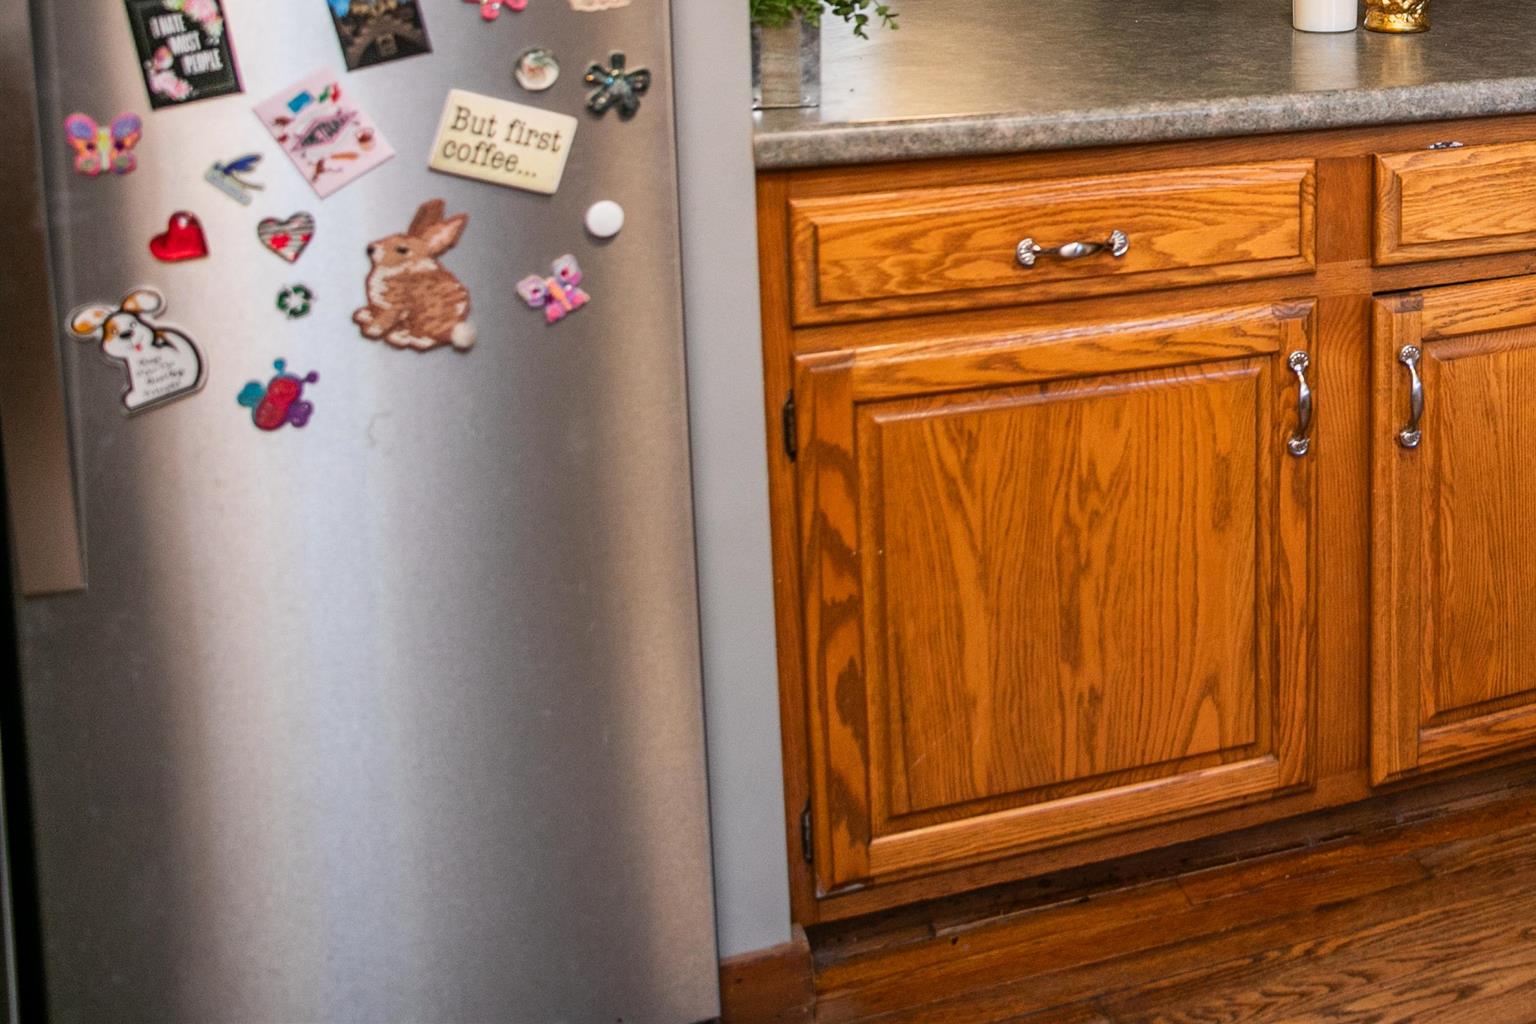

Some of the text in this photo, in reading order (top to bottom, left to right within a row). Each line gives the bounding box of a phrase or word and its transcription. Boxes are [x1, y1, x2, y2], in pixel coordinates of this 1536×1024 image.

[159, 13, 187, 37] HATE
[166, 29, 202, 56] MOST
[181, 47, 224, 76] PEOPLE
[450, 104, 562, 153] But first
[442, 138, 538, 178] coffee...
